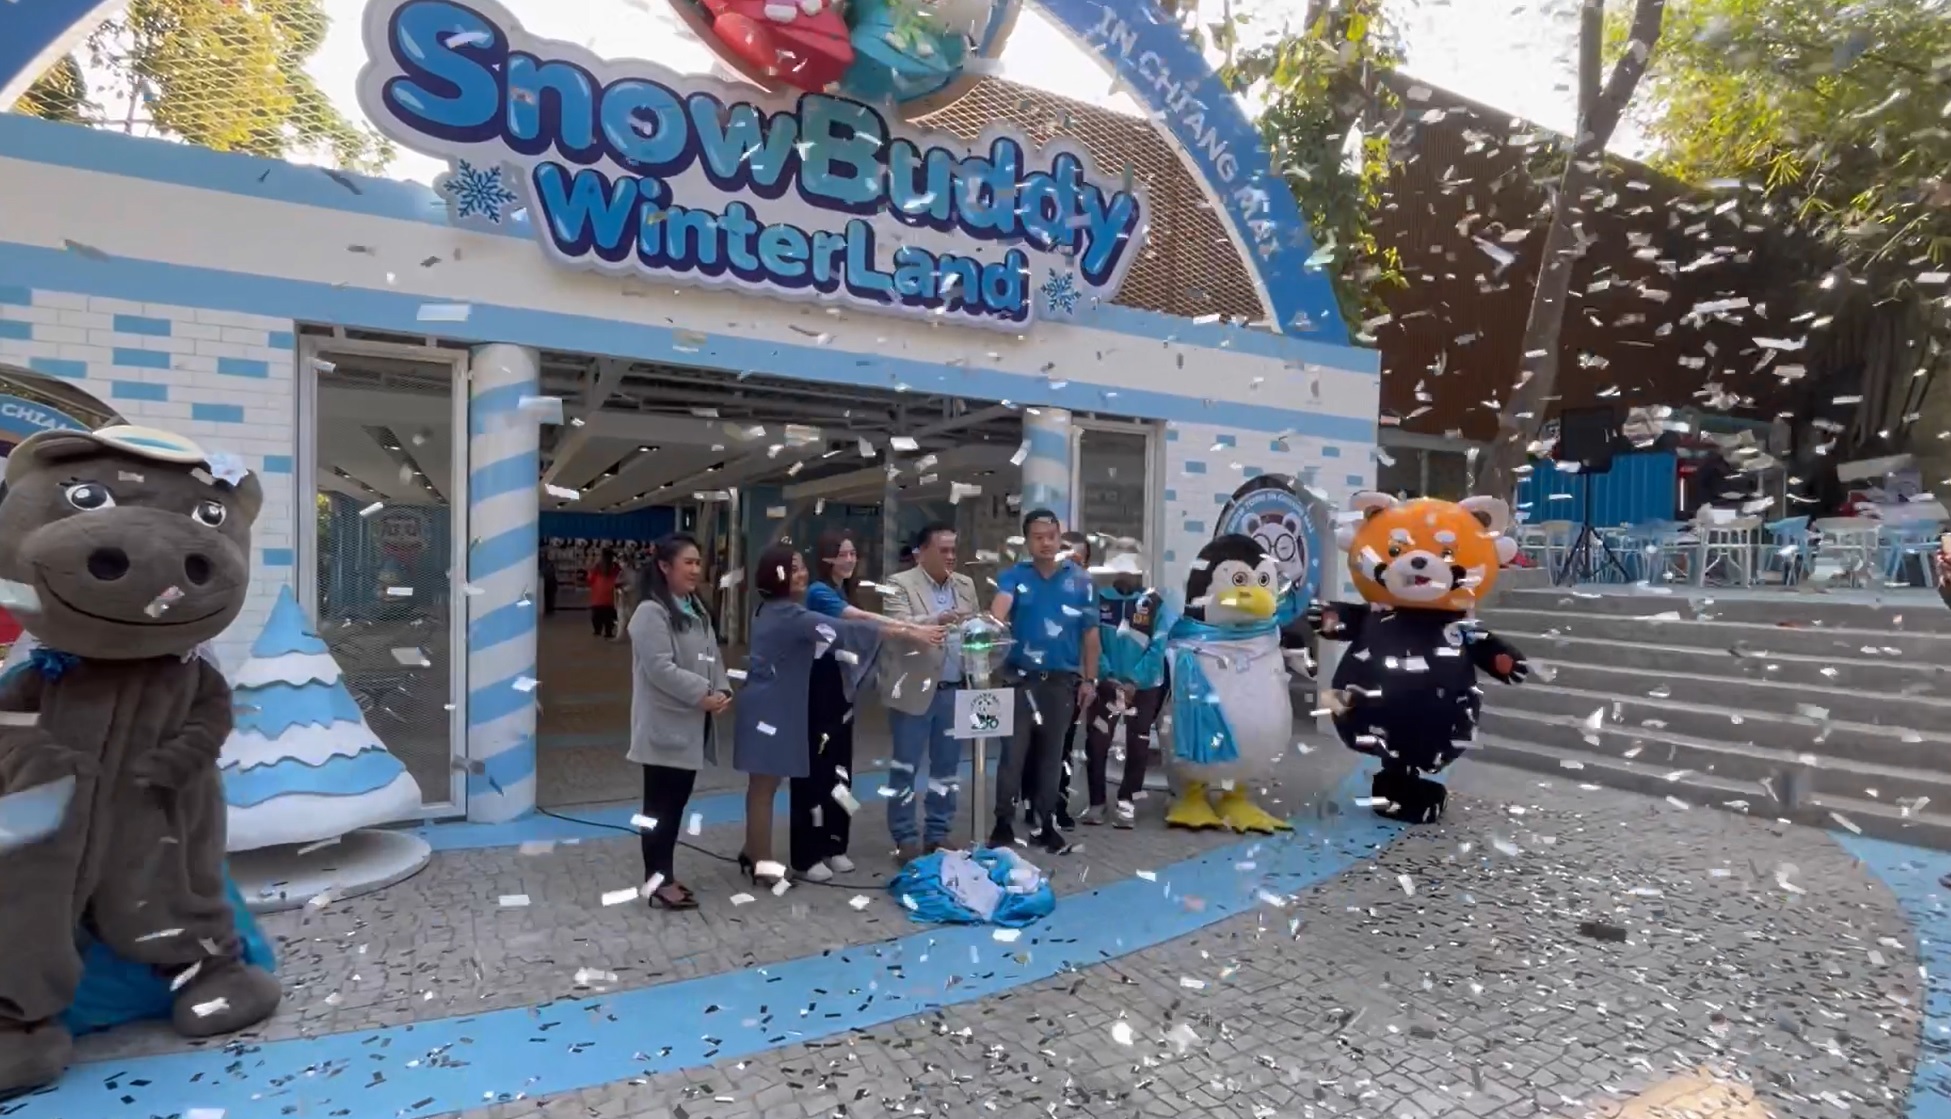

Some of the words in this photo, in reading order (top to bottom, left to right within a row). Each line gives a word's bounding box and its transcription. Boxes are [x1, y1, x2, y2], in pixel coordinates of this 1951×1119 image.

[382, 0, 1139, 287] SnowBuddy
[1139, 51, 1239, 182] CHIANG
[533, 161, 1029, 322] WinterLand
